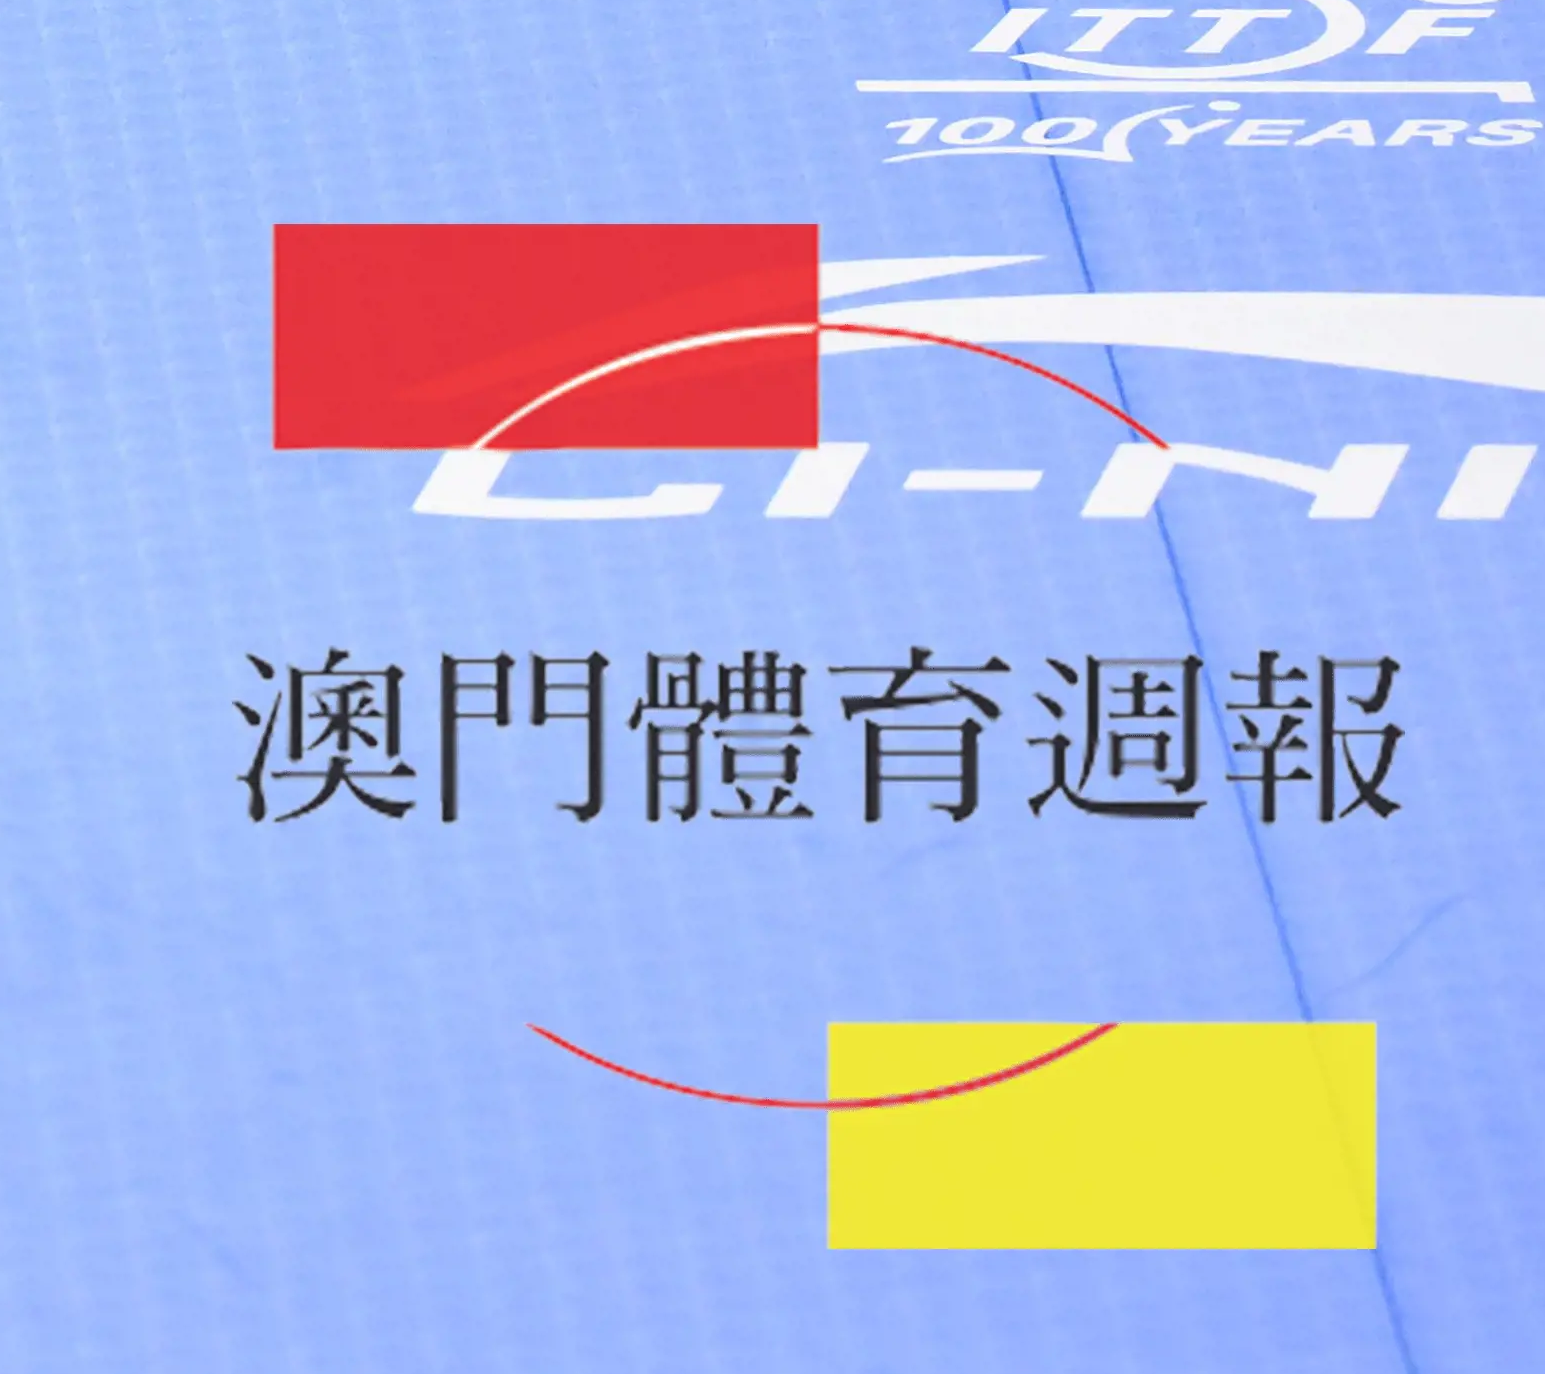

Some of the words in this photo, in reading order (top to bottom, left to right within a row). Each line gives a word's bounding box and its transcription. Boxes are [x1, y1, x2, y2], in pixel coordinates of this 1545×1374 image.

[969, 7, 1497, 55] ITTF
[884, 115, 1099, 145] 100
[1159, 116, 1544, 148] YEARS
